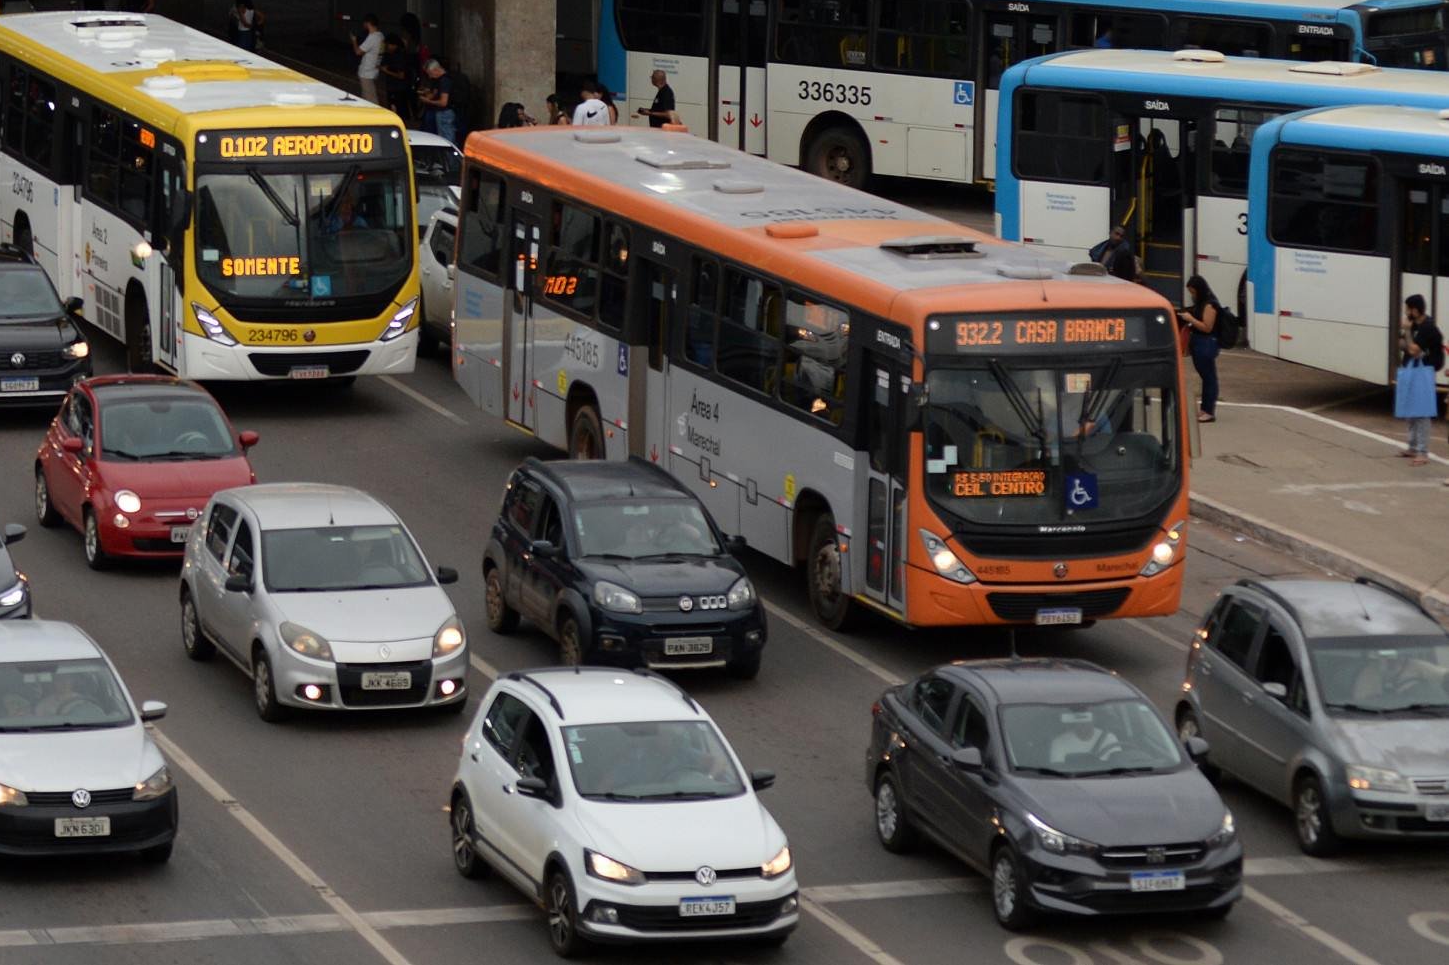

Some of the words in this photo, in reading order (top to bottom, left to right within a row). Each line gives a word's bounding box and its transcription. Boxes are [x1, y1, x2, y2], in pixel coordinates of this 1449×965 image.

[1008, 2, 1030, 12] SAÍDA
[1298, 24, 1334, 36] ENTRADA
[797, 79, 871, 106] 336335
[1145, 99, 1170, 111] SAÍDA
[220, 136, 267, 159] 0.102
[272, 133, 373, 157] AEROPORTO
[1418, 162, 1447, 176] SAÍDA
[221, 256, 301, 277] SOMENTE
[248, 329, 299, 342] 234796
[876, 329, 901, 349] ENTRADA
[955, 322, 1003, 345] 932.2
[1014, 321, 1058, 345] CASA
[1063, 319, 1126, 343] BRANCA
[564, 332, 599, 370] 445185
[690, 387, 712, 421] Área
[711, 402, 719, 423] 4
[687, 424, 721, 457] Marechal
[990, 482, 1046, 495] CENTRO
[1096, 562, 1139, 573] Marechal
